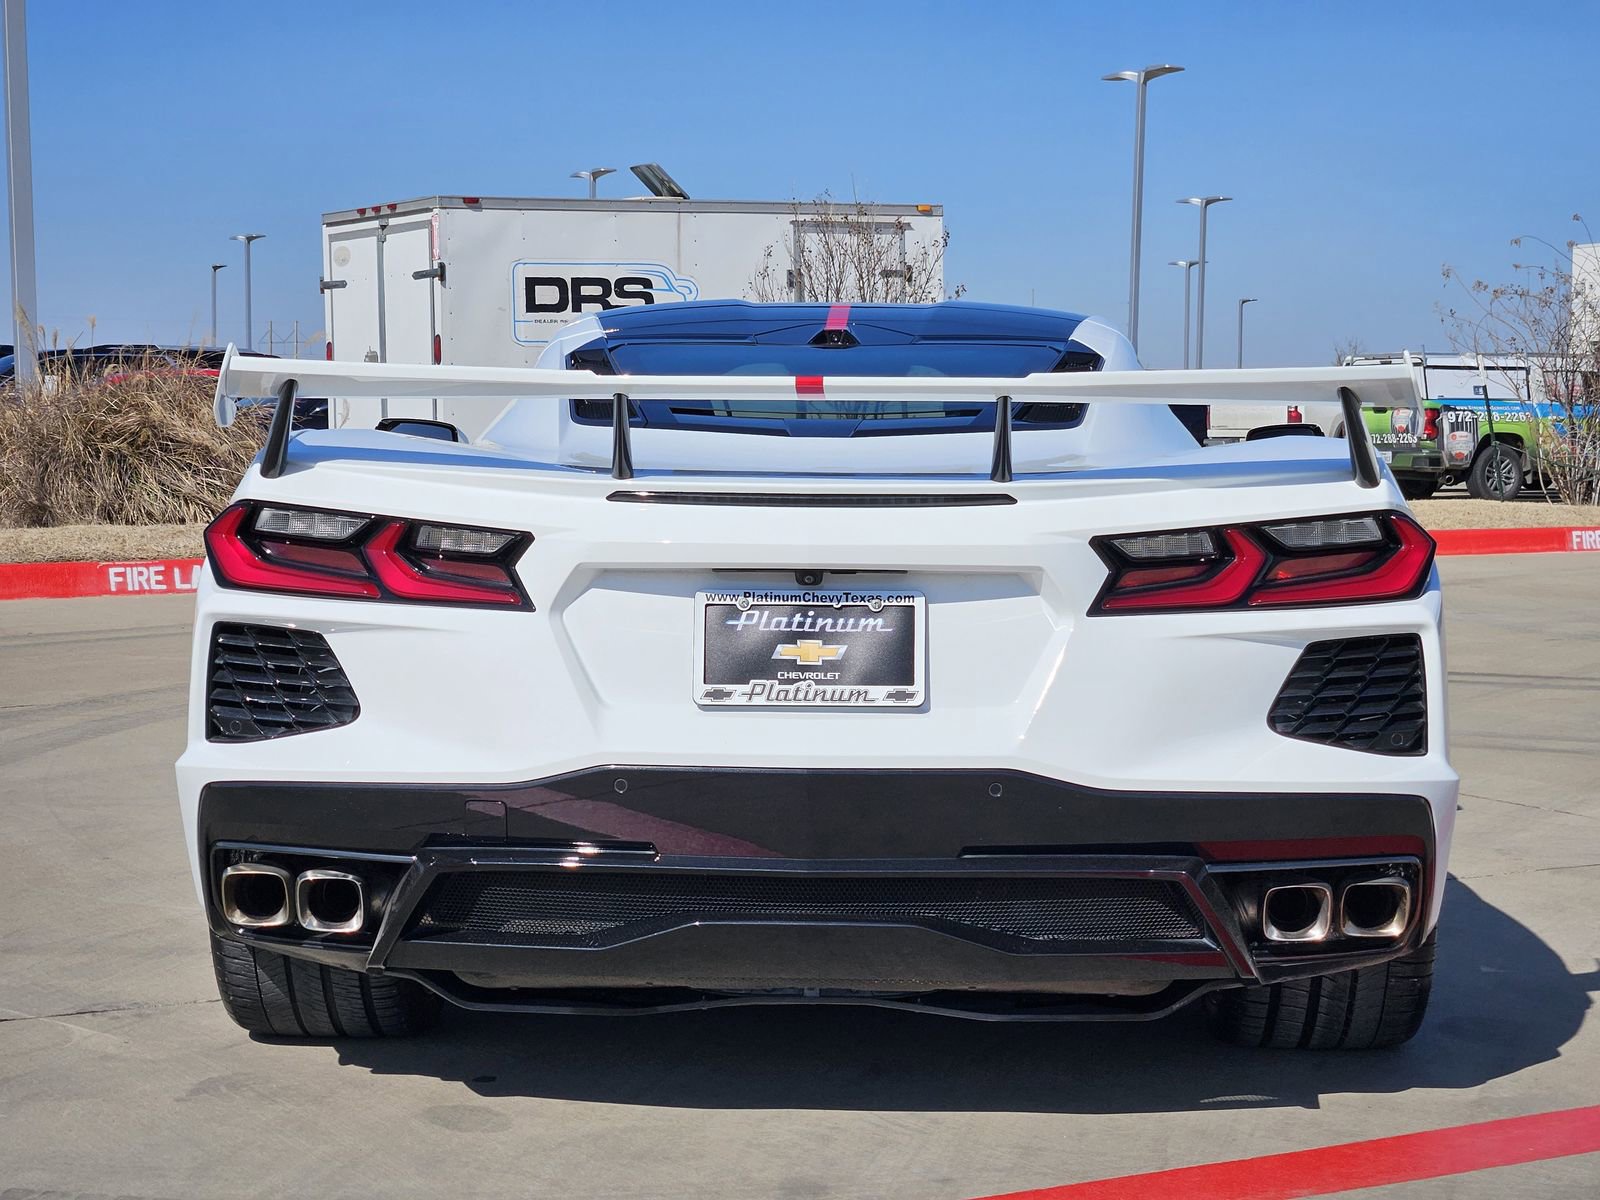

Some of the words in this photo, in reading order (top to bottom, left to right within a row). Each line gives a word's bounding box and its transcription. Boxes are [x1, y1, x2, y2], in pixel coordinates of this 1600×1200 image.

[525, 277, 655, 313] DRS
[108, 566, 167, 591] FIRE
[705, 591, 915, 605] www.PlatinumChevyTexas.com
[725, 610, 893, 632] Platinum
[777, 671, 841, 680] CHEVROLET
[739, 682, 877, 704] Platinum
